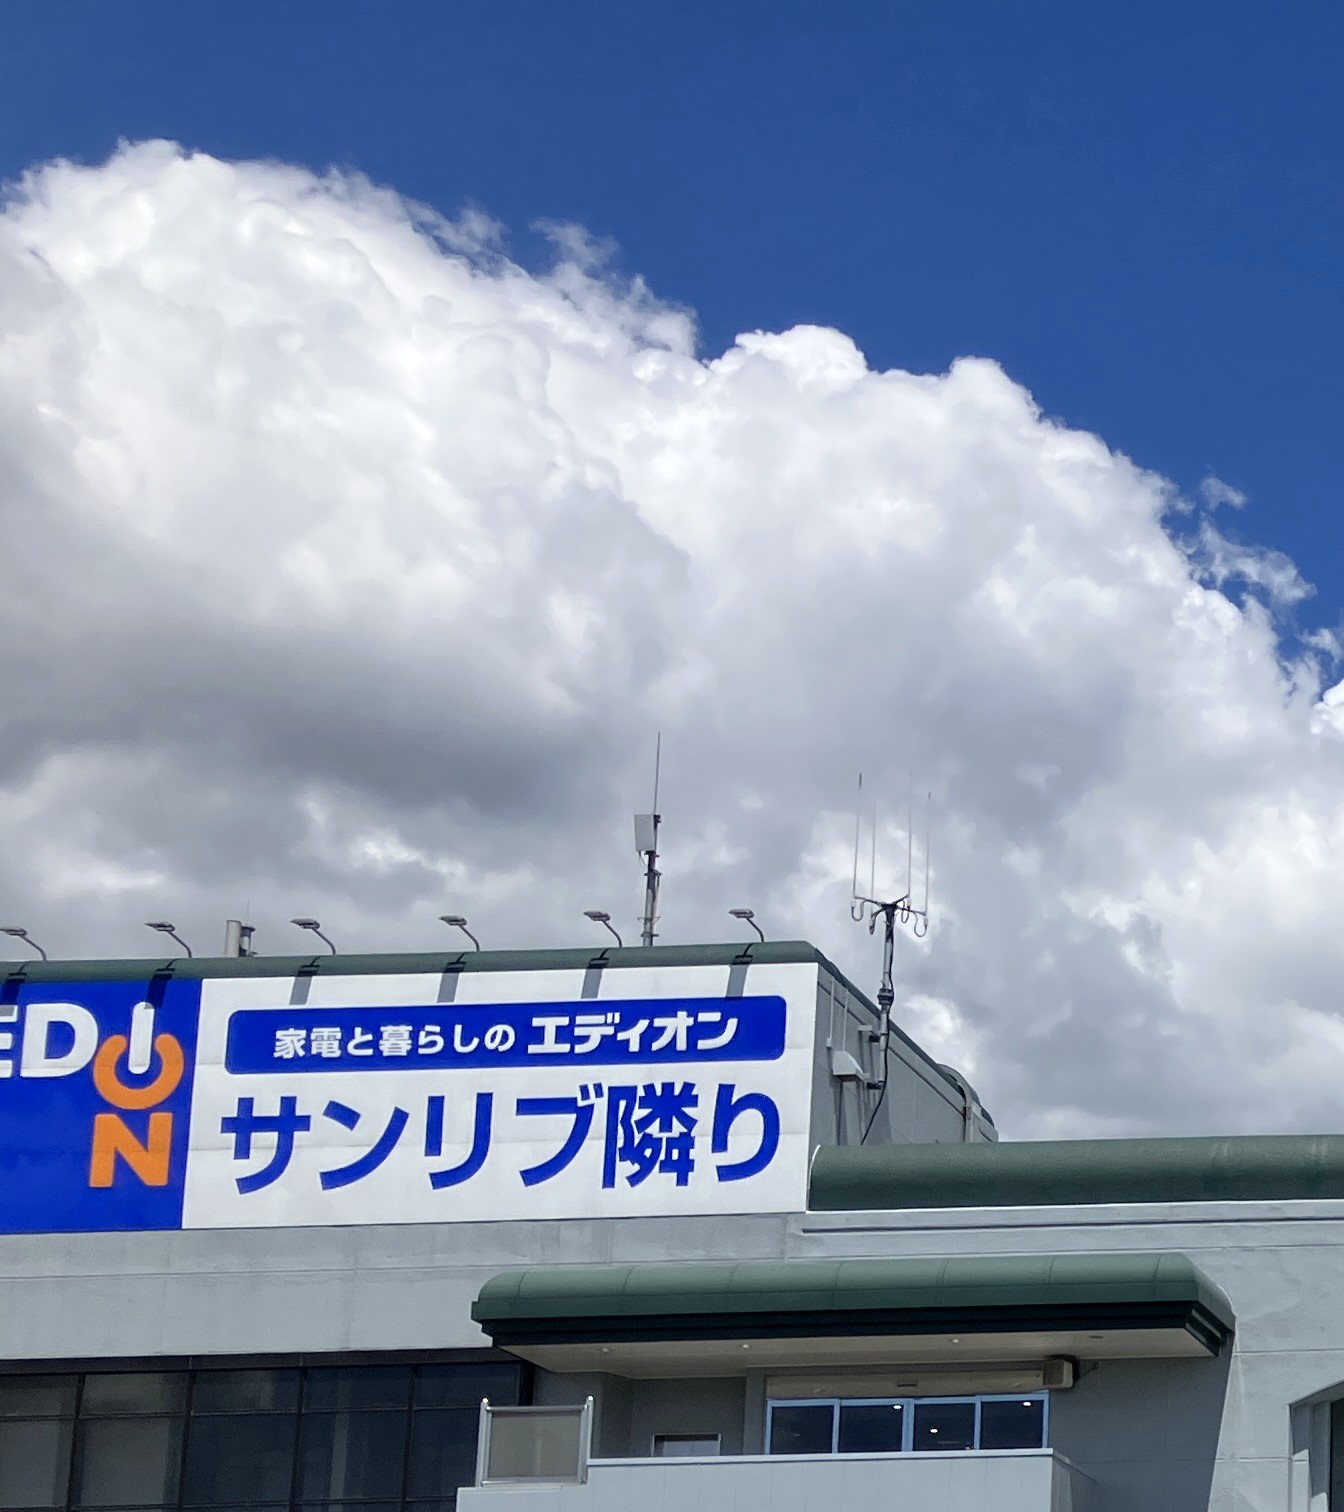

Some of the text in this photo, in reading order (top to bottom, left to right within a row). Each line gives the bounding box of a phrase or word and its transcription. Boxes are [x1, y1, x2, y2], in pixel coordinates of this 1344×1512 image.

[0, 1001, 185, 1188] DION
[220, 1081, 782, 1194] サンリブ隣り
